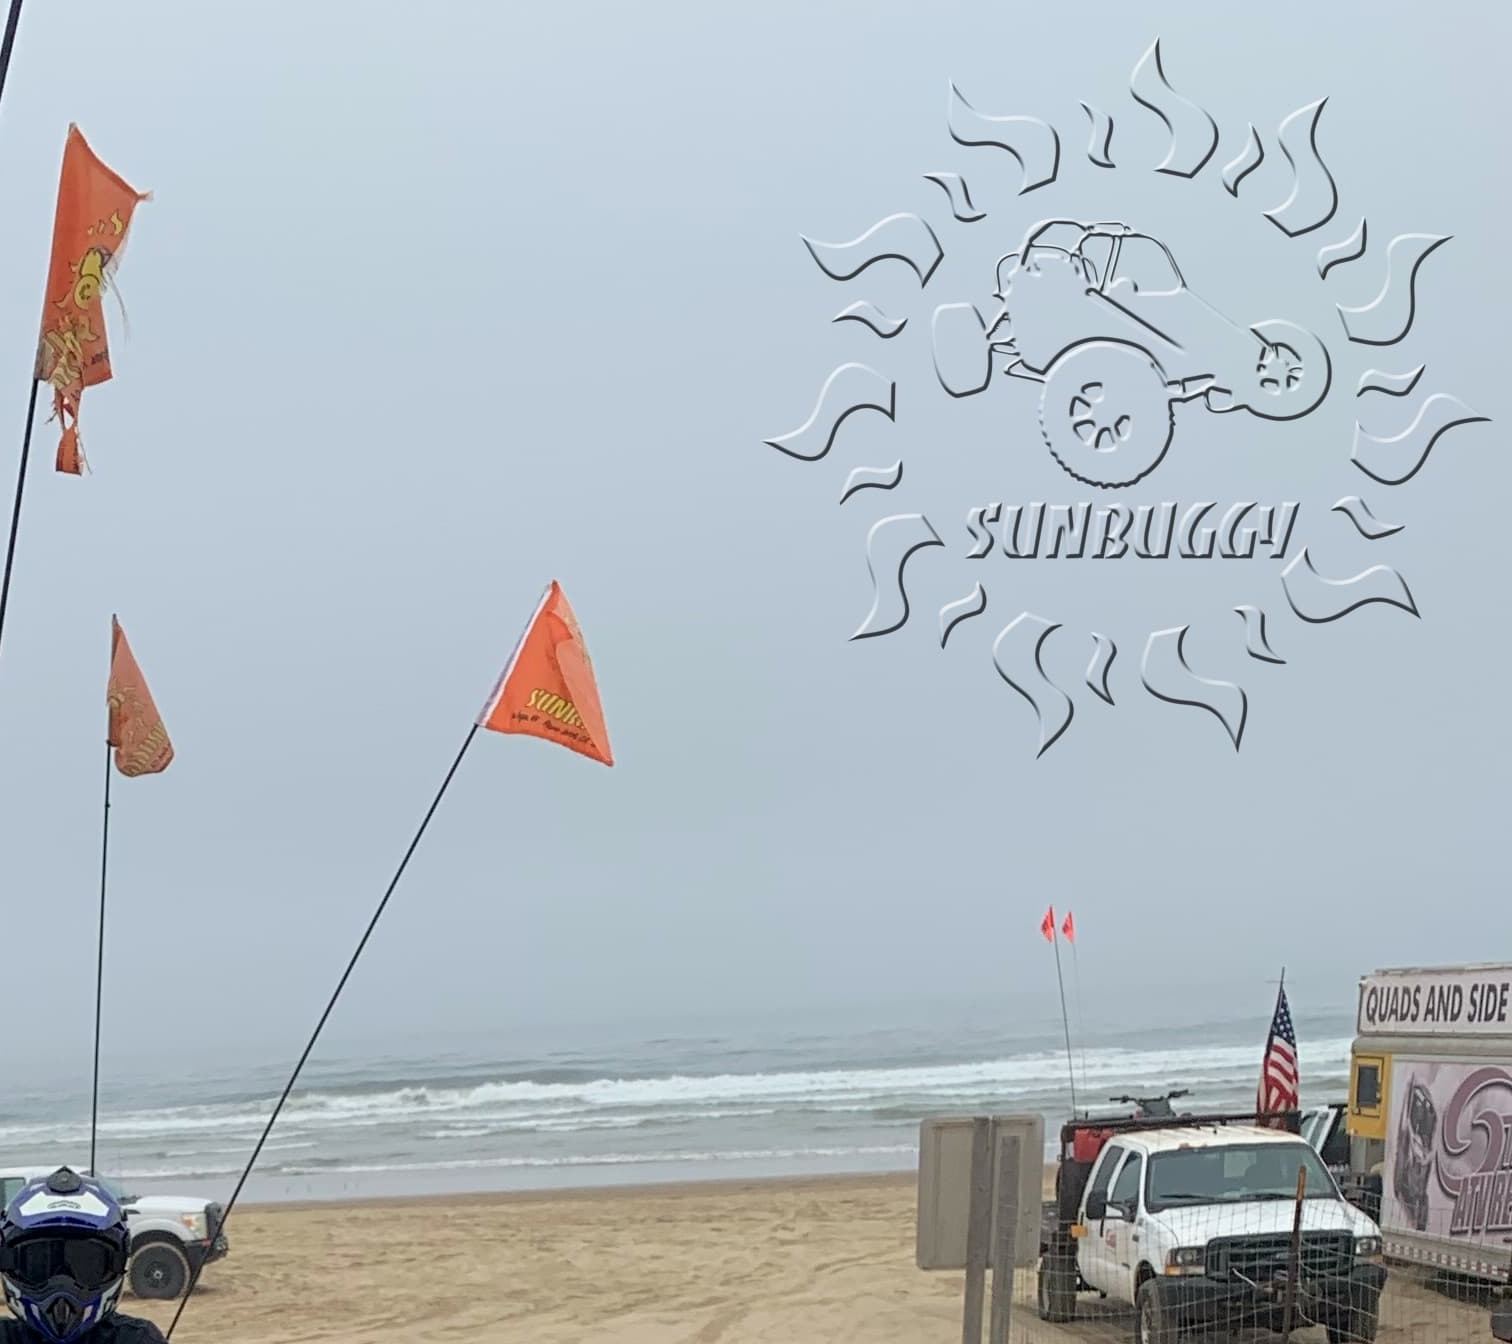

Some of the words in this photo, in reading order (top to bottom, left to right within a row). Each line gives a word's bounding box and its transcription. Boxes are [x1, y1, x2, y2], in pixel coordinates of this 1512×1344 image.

[1366, 984, 1421, 1025] QUADS
[1423, 984, 1463, 1023] AND
[1467, 982, 1510, 1023] SIDE
